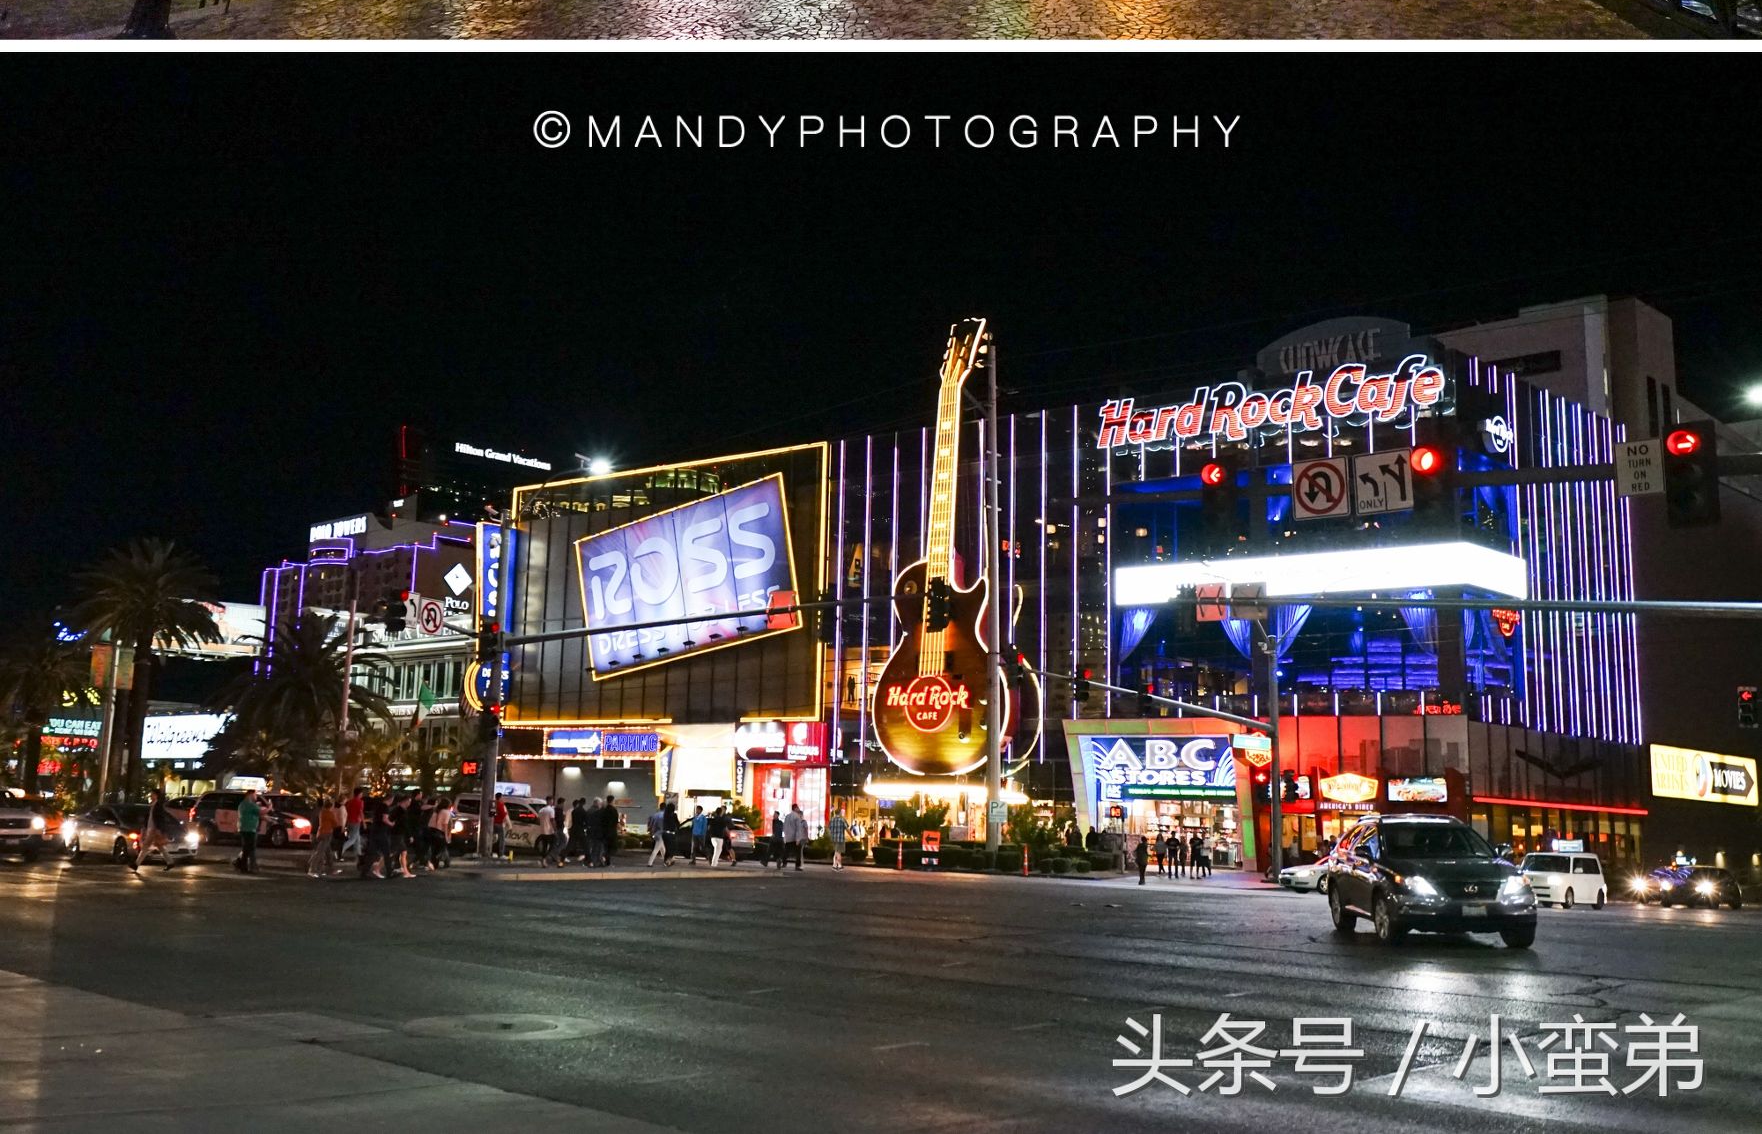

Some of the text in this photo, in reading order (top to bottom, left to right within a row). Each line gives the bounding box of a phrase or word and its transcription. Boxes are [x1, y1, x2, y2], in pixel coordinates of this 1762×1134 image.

[1096, 353, 1446, 449] Hard Rock Cafe
[455, 442, 552, 471] Hilton Grand Vacations
[1627, 444, 1649, 457] NO
[1627, 457, 1652, 469] TURN
[1633, 470, 1647, 480] ON
[1631, 482, 1650, 492] RED
[1359, 497, 1385, 510] ONLY
[332, 516, 367, 538] TOWERS
[588, 501, 776, 621] ROSS
[444, 596, 470, 610] POLO
[886, 684, 969, 709] Hard Rock
[916, 711, 938, 721] CAFE
[603, 733, 659, 752] PARKING
[1100, 738, 1217, 771] ABC
[1110, 769, 1207, 786] STORES
[1713, 768, 1747, 791] MOVIES
[1319, 802, 1374, 811] AMERICA'S DINER
